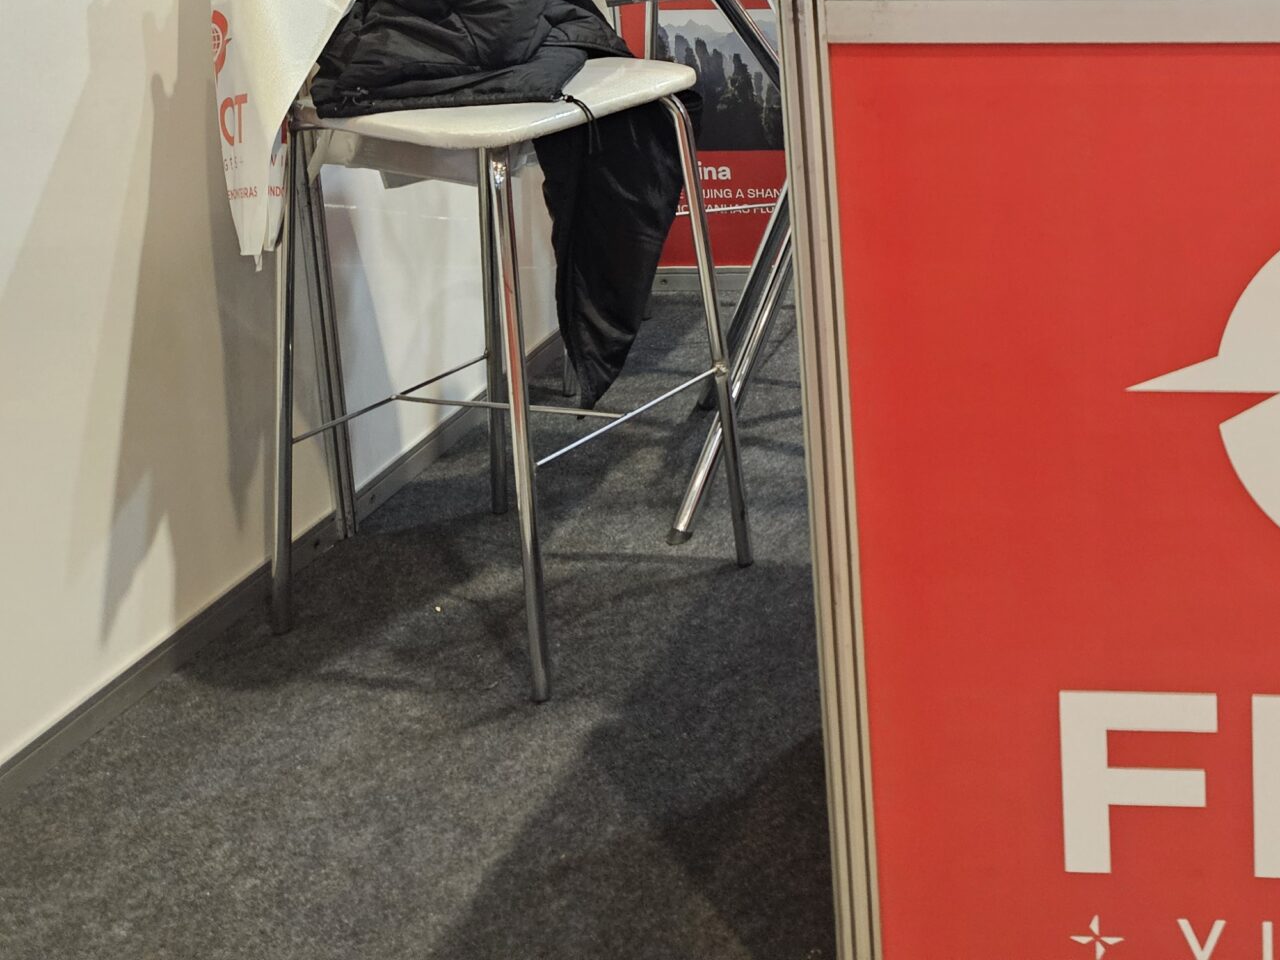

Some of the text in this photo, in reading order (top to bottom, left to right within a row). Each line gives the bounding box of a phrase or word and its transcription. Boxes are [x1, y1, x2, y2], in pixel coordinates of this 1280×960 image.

[698, 161, 732, 181] ina
[702, 187, 783, 199] IJING A SHAN
